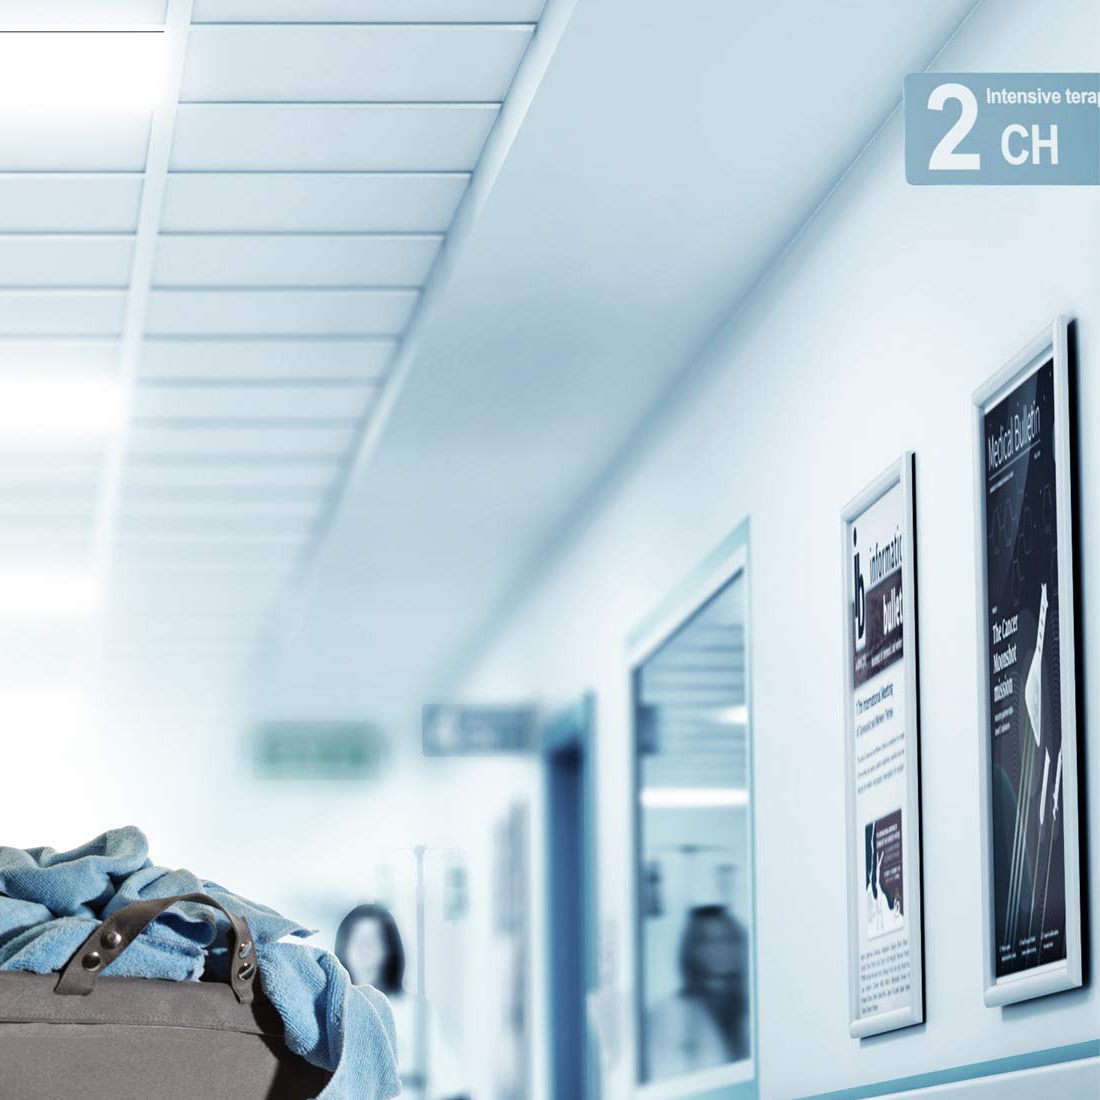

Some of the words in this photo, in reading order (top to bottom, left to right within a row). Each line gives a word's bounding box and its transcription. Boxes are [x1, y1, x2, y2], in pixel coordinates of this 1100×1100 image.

[986, 88, 1061, 105] Intensive
[1065, 88, 1100, 108] tera
[927, 83, 980, 170] 2
[1001, 123, 1059, 166] CH
[988, 416, 1014, 472] Medical
[1014, 400, 1041, 452] Bulletin
[992, 621, 1002, 645] The
[1001, 614, 1018, 640] Cancer
[993, 643, 1017, 674] Moonshot
[994, 674, 1013, 702] mission
